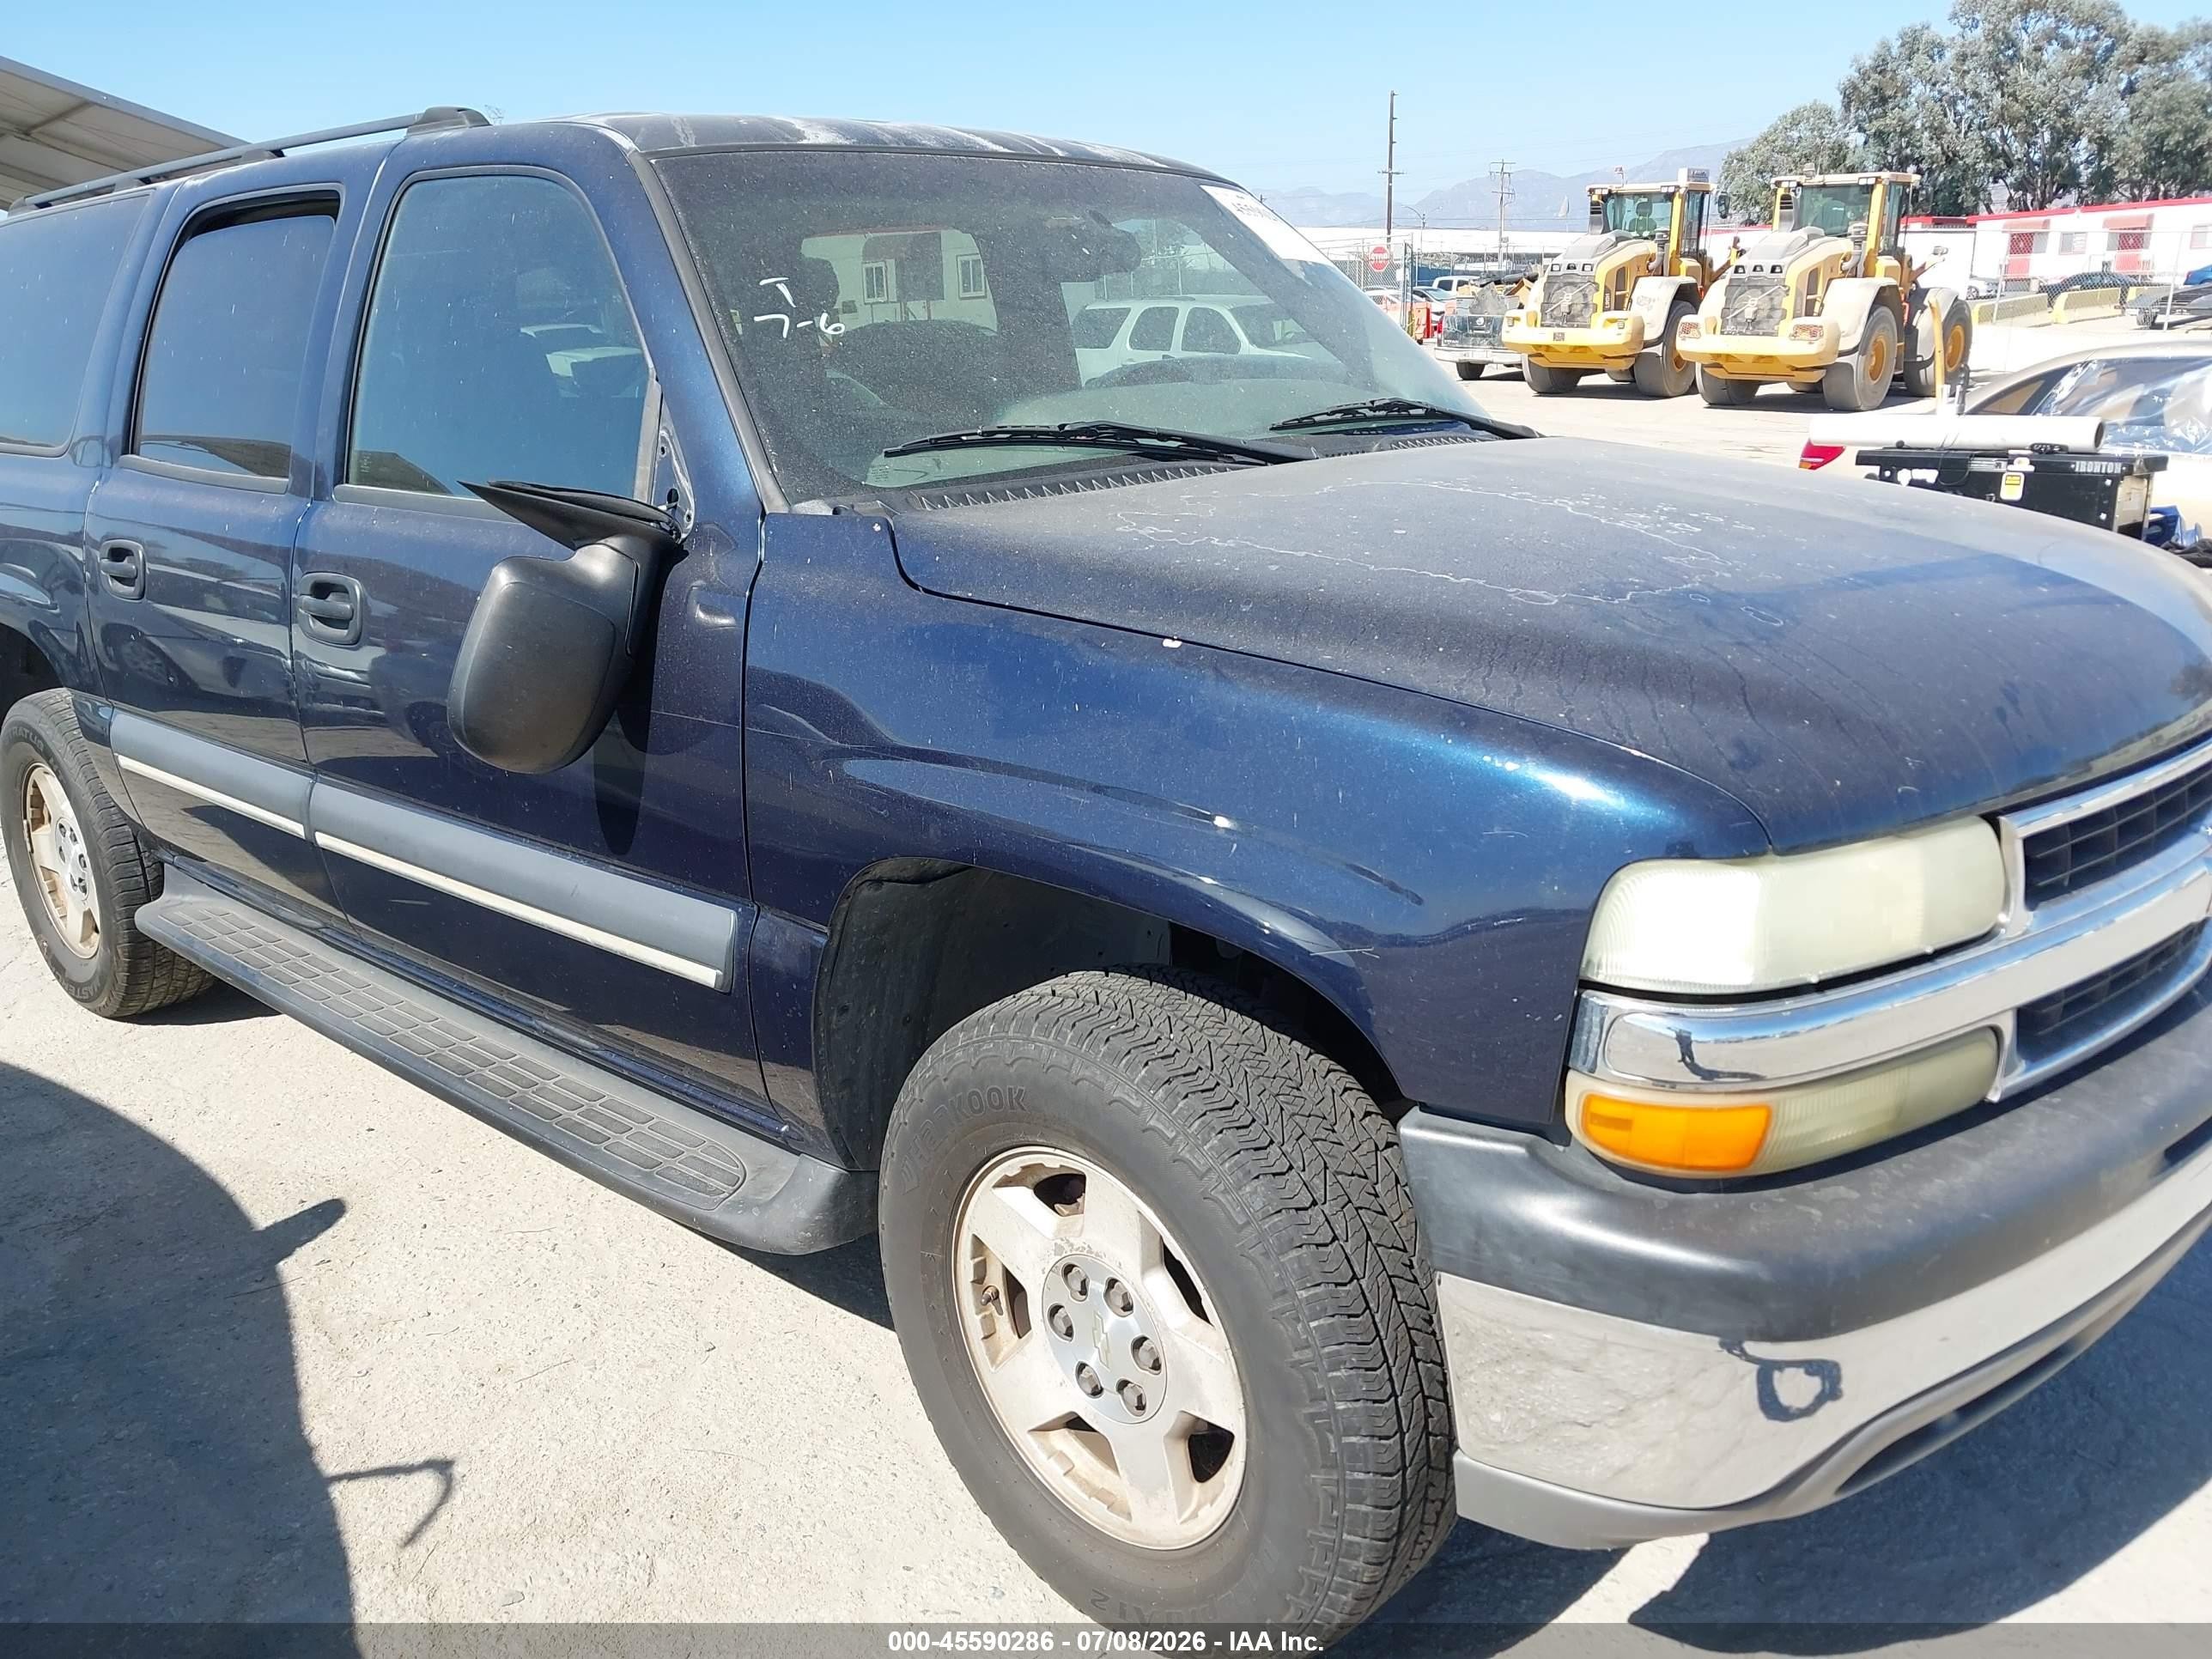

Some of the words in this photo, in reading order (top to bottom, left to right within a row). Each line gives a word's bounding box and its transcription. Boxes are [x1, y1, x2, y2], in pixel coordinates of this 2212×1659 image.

[1370, 252, 1389, 264] STOP
[753, 312, 846, 339] 7-6
[2075, 460, 2122, 474] IRONTON
